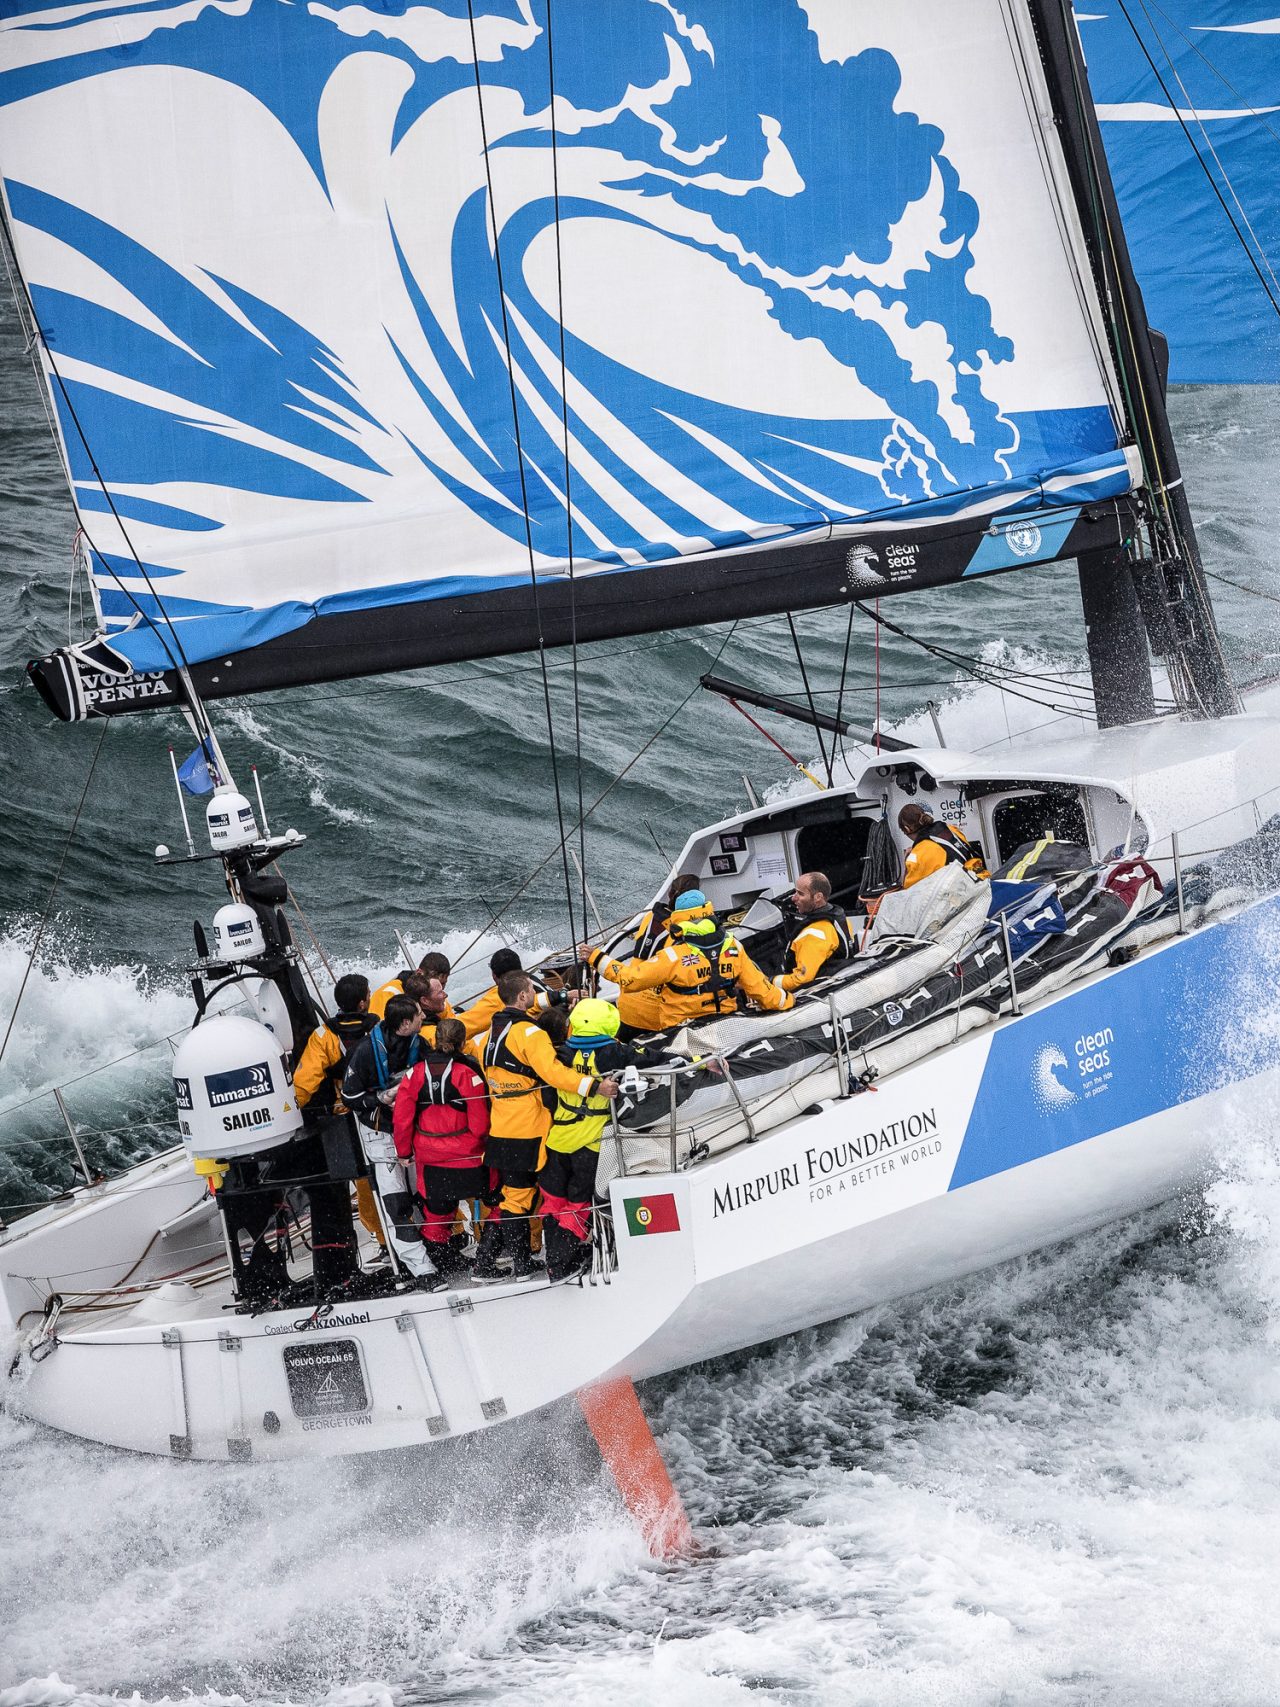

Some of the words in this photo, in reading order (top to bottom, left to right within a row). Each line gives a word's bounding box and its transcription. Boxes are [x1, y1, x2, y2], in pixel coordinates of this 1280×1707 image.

[885, 544, 920, 557] clean
[887, 555, 916, 568] seas
[84, 680, 172, 705] PENTA
[233, 937, 253, 947] SAILOR
[696, 963, 732, 979] WAER
[1075, 1027, 1114, 1056] clean
[1078, 1049, 1111, 1077] seas
[1082, 1080, 1094, 1089] turn
[1094, 1076, 1103, 1084] the
[1103, 1071, 1114, 1081] tide
[211, 1081, 271, 1105] inmarsat
[1084, 1091, 1092, 1099] on
[1092, 1083, 1109, 1097] plastic
[222, 1107, 273, 1132] SAILOR
[809, 1184, 833, 1203] FOR
[839, 1179, 846, 1192] A
[851, 1159, 896, 1187] BETTER
[900, 1140, 942, 1165] WORLD
[264, 1323, 294, 1336] Coated
[290, 1357, 314, 1367] VOLVO
[316, 1354, 342, 1365] OCEAN
[343, 1353, 354, 1362] 65
[302, 1415, 373, 1432] GEORGETOWN
